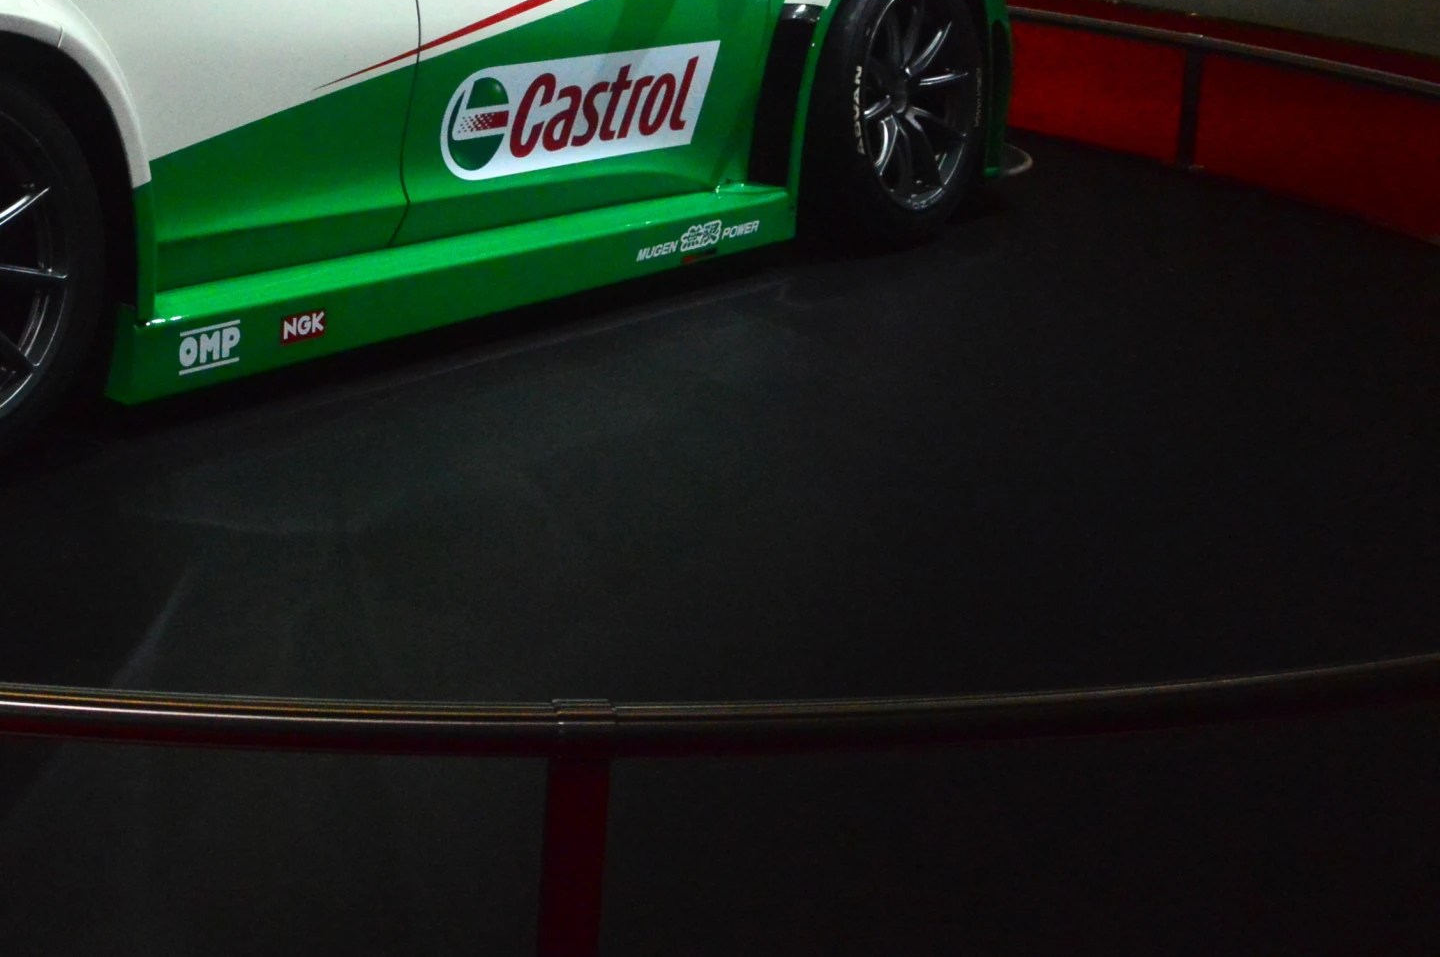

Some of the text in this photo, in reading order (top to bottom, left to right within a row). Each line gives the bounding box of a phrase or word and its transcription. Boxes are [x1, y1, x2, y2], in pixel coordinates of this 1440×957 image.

[509, 55, 700, 159] Castrol
[635, 240, 679, 262] MUGEN
[721, 220, 760, 240] POWER
[283, 311, 325, 340] NGK
[179, 326, 241, 368] OMP
